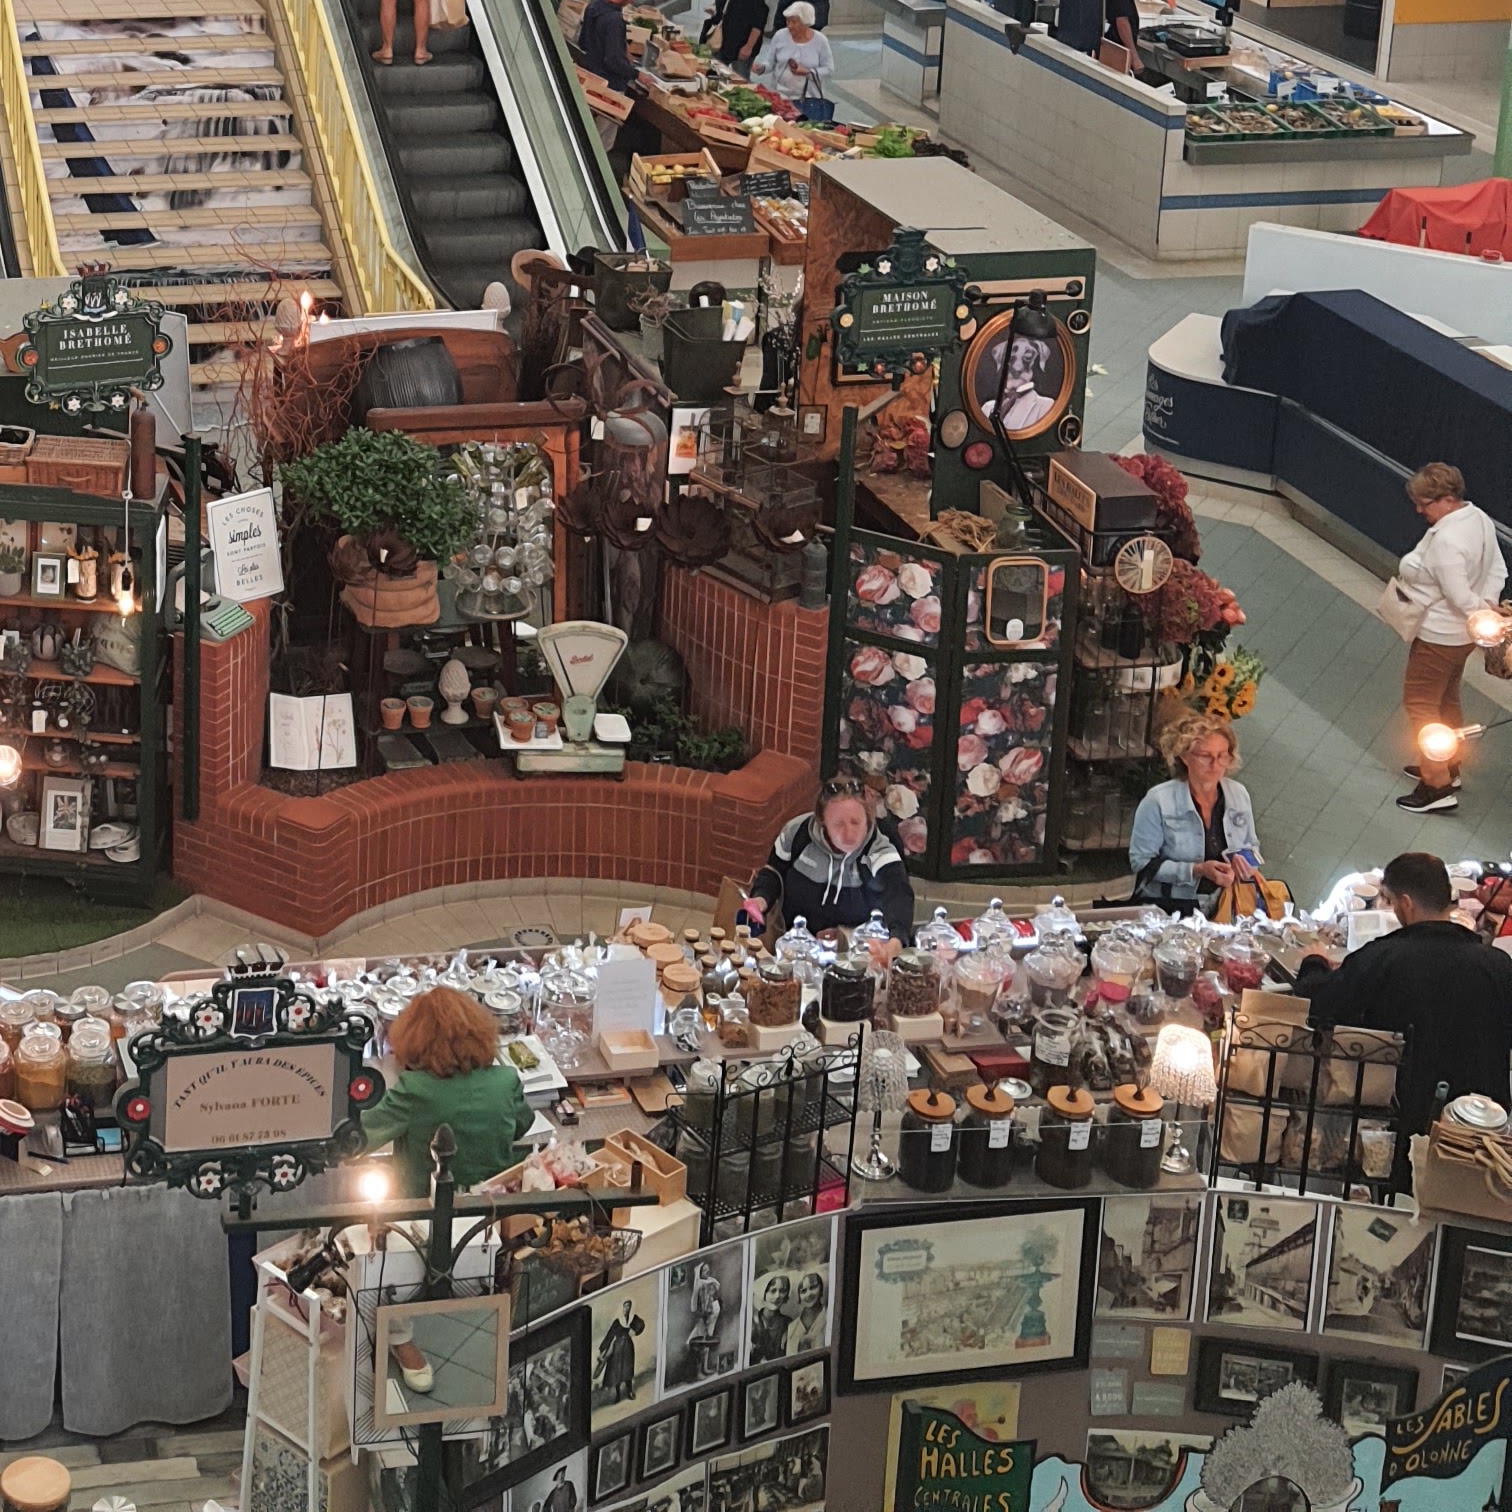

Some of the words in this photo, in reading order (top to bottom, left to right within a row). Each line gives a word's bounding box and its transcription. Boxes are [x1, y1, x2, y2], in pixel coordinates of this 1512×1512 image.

[872, 298, 937, 314] BRETHOMÉ
[882, 290, 929, 303] MAISON
[59, 332, 132, 351] BRETHOMÉ
[63, 323, 128, 340] ISABELLE
[222, 512, 234, 526] LES
[235, 506, 265, 518] CHOSES
[228, 522, 262, 547] simples
[236, 574, 264, 587] BELLES
[173, 1081, 197, 1110] TANT
[241, 1056, 271, 1067] AURA
[272, 1058, 296, 1072] DES
[251, 1093, 301, 1110] FORTE
[1391, 1376, 1510, 1456] SABLES
[1396, 1415, 1425, 1436] LES
[925, 1419, 962, 1449] LES
[919, 1446, 1015, 1481] HALLES
